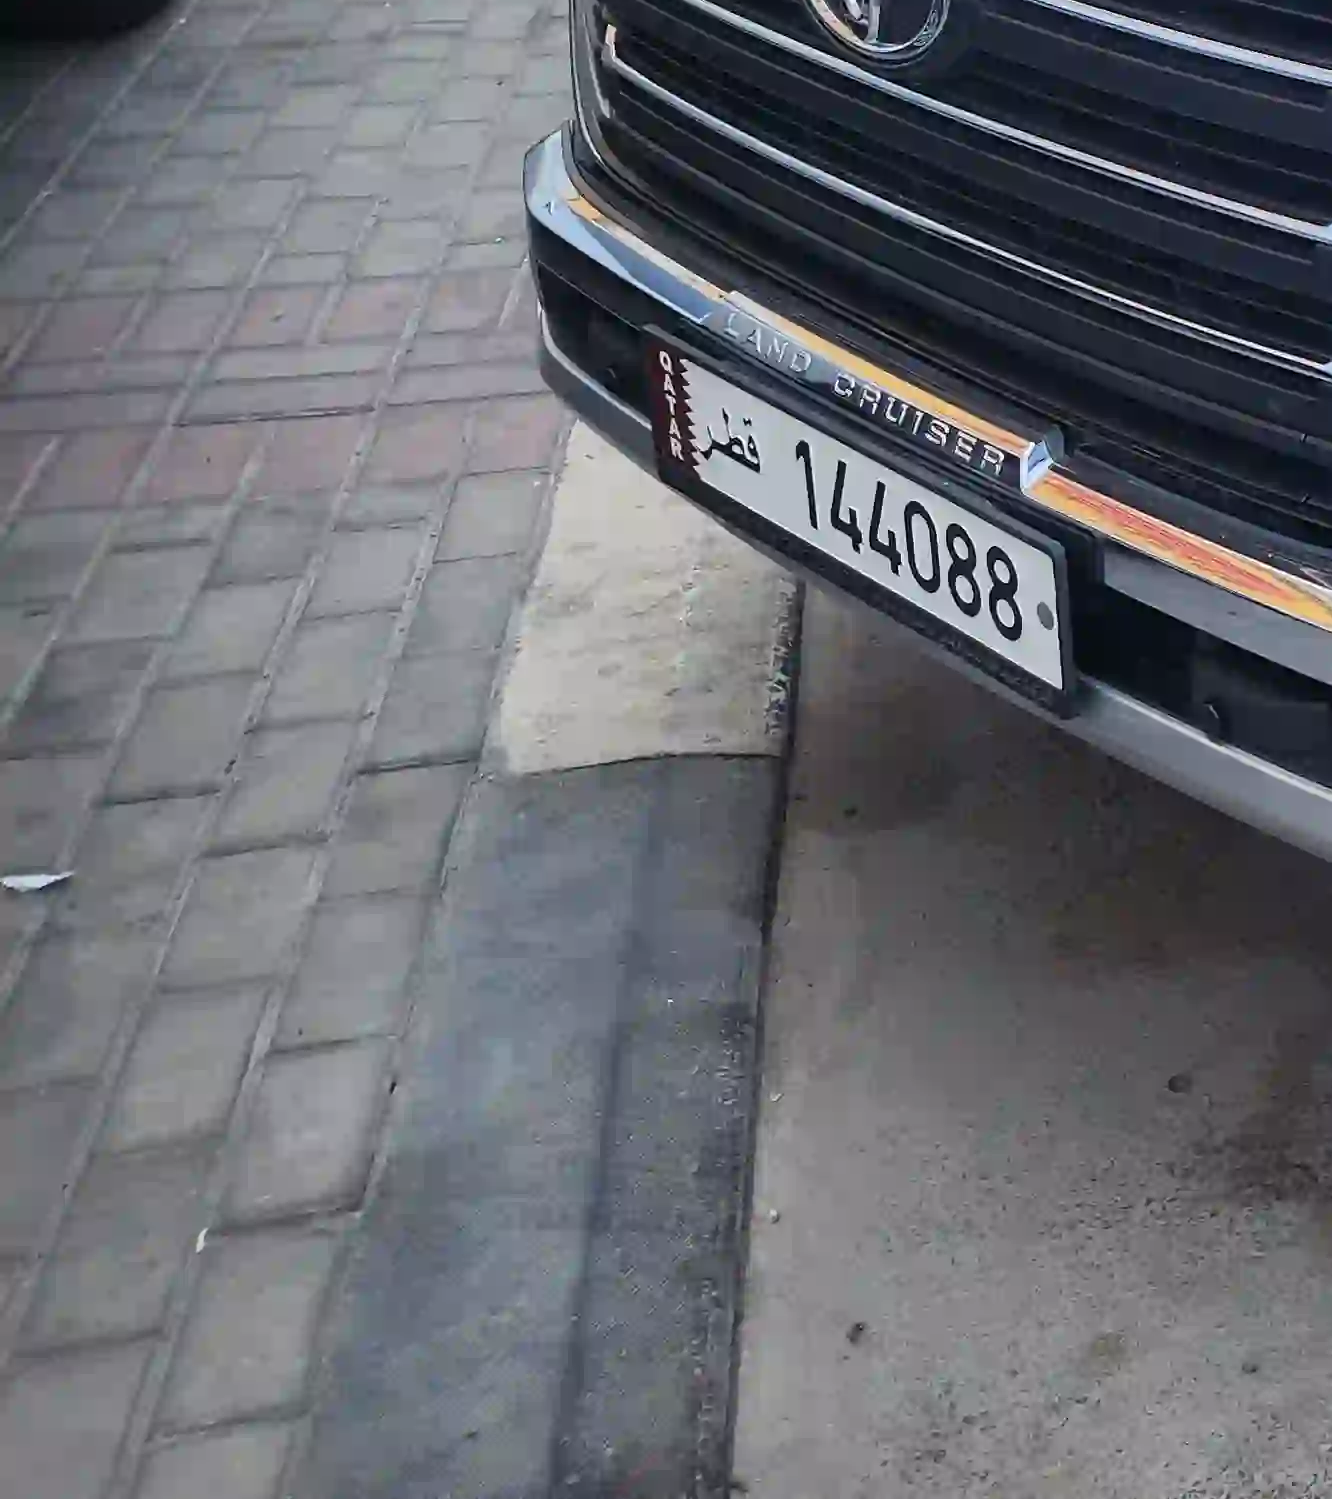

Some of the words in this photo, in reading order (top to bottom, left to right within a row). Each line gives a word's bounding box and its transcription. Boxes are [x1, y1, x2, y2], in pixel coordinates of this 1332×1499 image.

[659, 350, 685, 462] QATAR
[701, 407, 761, 474] قطر
[724, 312, 813, 373] LAND
[833, 371, 1005, 476] CRUISER
[796, 439, 1023, 642] 144088
